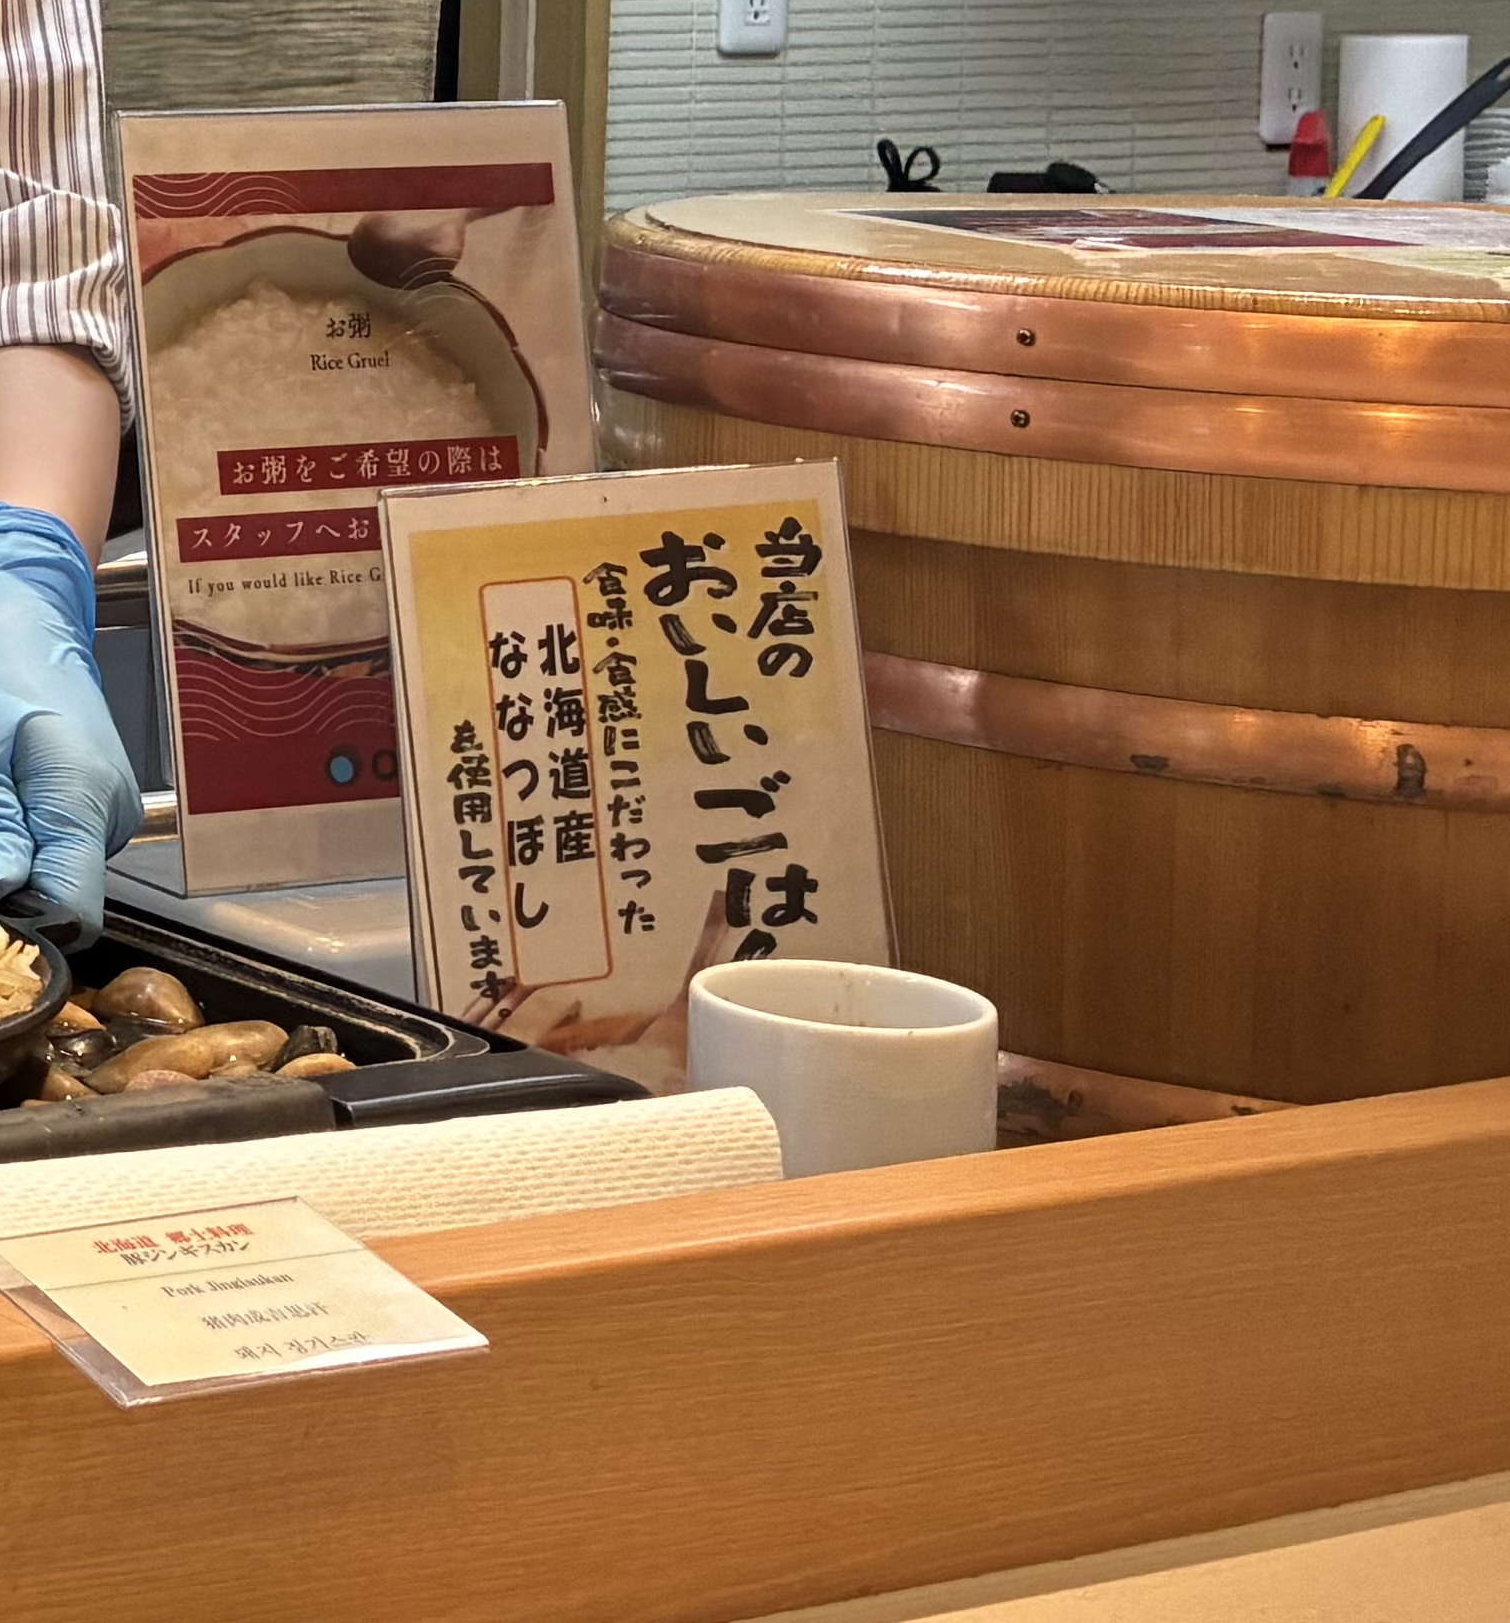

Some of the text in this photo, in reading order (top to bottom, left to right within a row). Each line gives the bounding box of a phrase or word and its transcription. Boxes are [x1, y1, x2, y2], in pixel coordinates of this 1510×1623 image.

[326, 312, 371, 339] お粥
[310, 350, 390, 371] Rice Gruel
[232, 445, 504, 485] お粥をご希望の際は
[190, 517, 381, 549] スタッフへお
[207, 580, 235, 597] you
[242, 573, 287, 590] would
[294, 572, 324, 587] like
[330, 569, 362, 584] Rice
[747, 516, 823, 677] 当店の
[538, 623, 595, 864] 北海道産
[489, 631, 549, 929] ななつぼし
[160, 1282, 203, 1298] Pork
